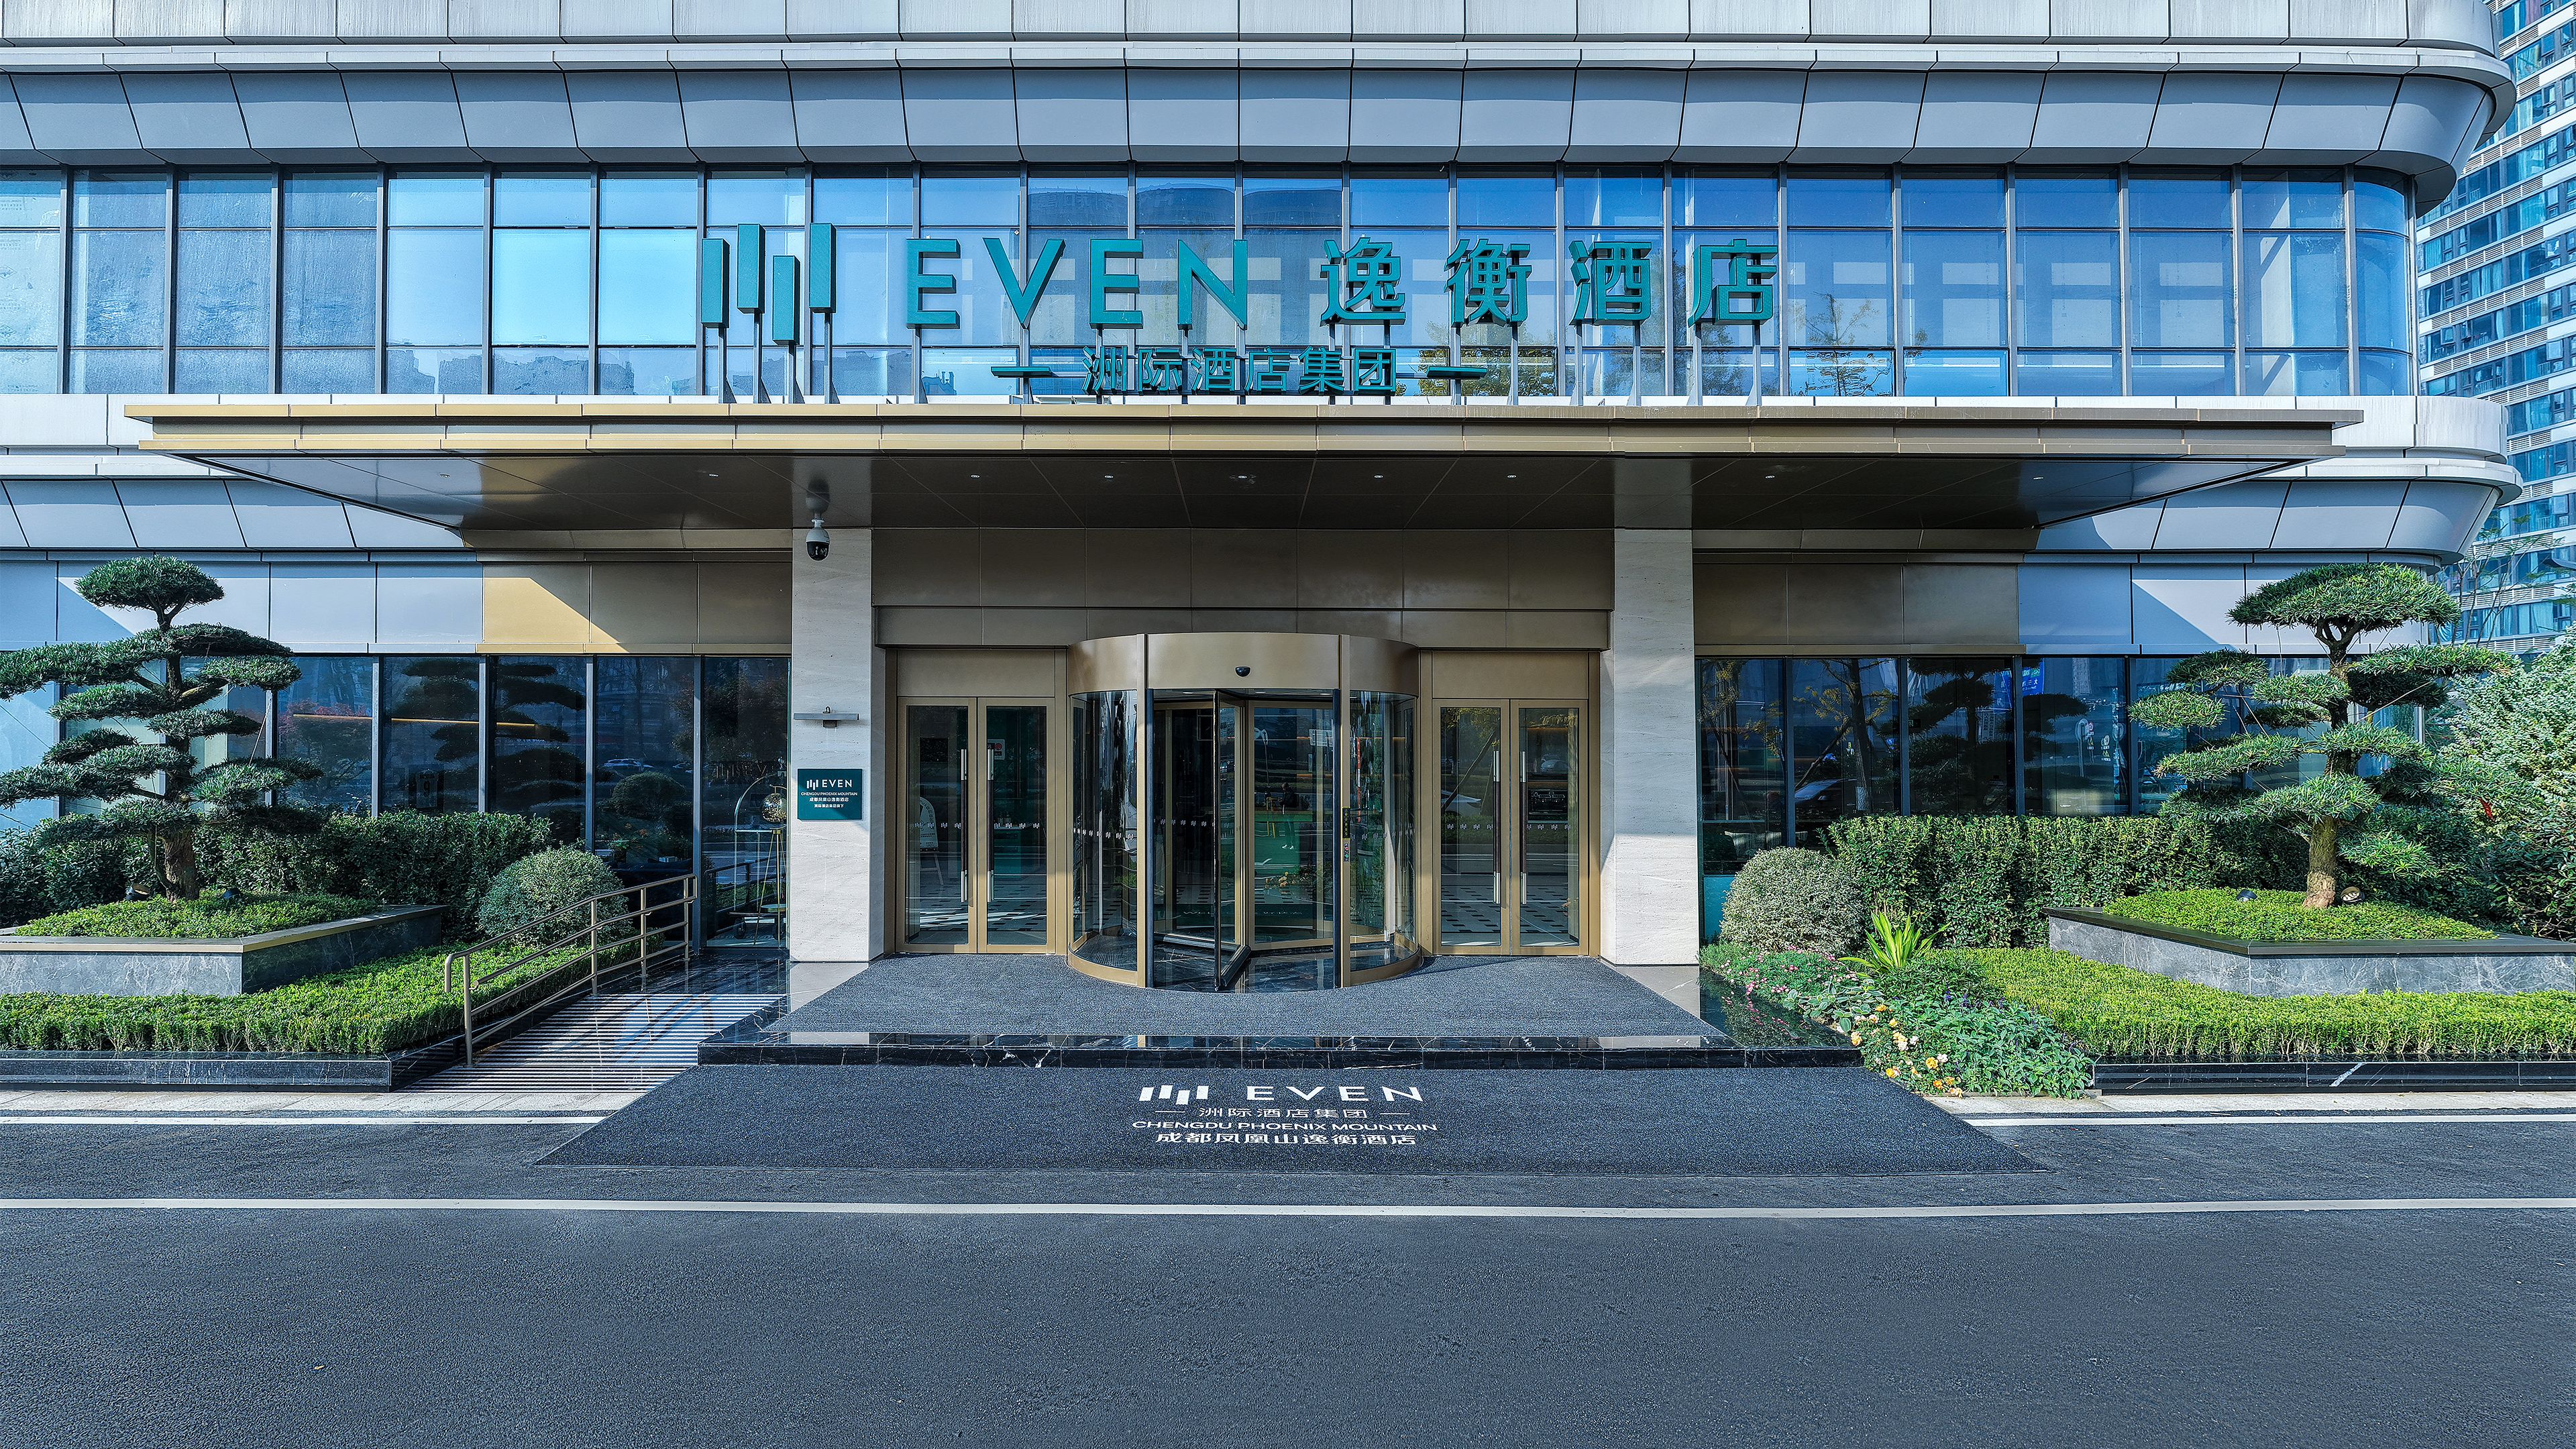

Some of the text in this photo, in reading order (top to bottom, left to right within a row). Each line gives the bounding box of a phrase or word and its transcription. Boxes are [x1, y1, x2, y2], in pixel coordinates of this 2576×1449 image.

[906, 236, 1779, 330] EVEN 逸衡酒店
[1082, 345, 1397, 396] 洲际酒店集团
[822, 779, 852, 788] EVEN
[1246, 1085, 1424, 1102] EVEN
[1197, 1107, 1368, 1119] 洲际酒店集团
[1132, 1120, 1438, 1132] CHENGDU PHOENIX MOUNTAIN
[1155, 1132, 1417, 1146] 成都凤凰山逸衡酒店
